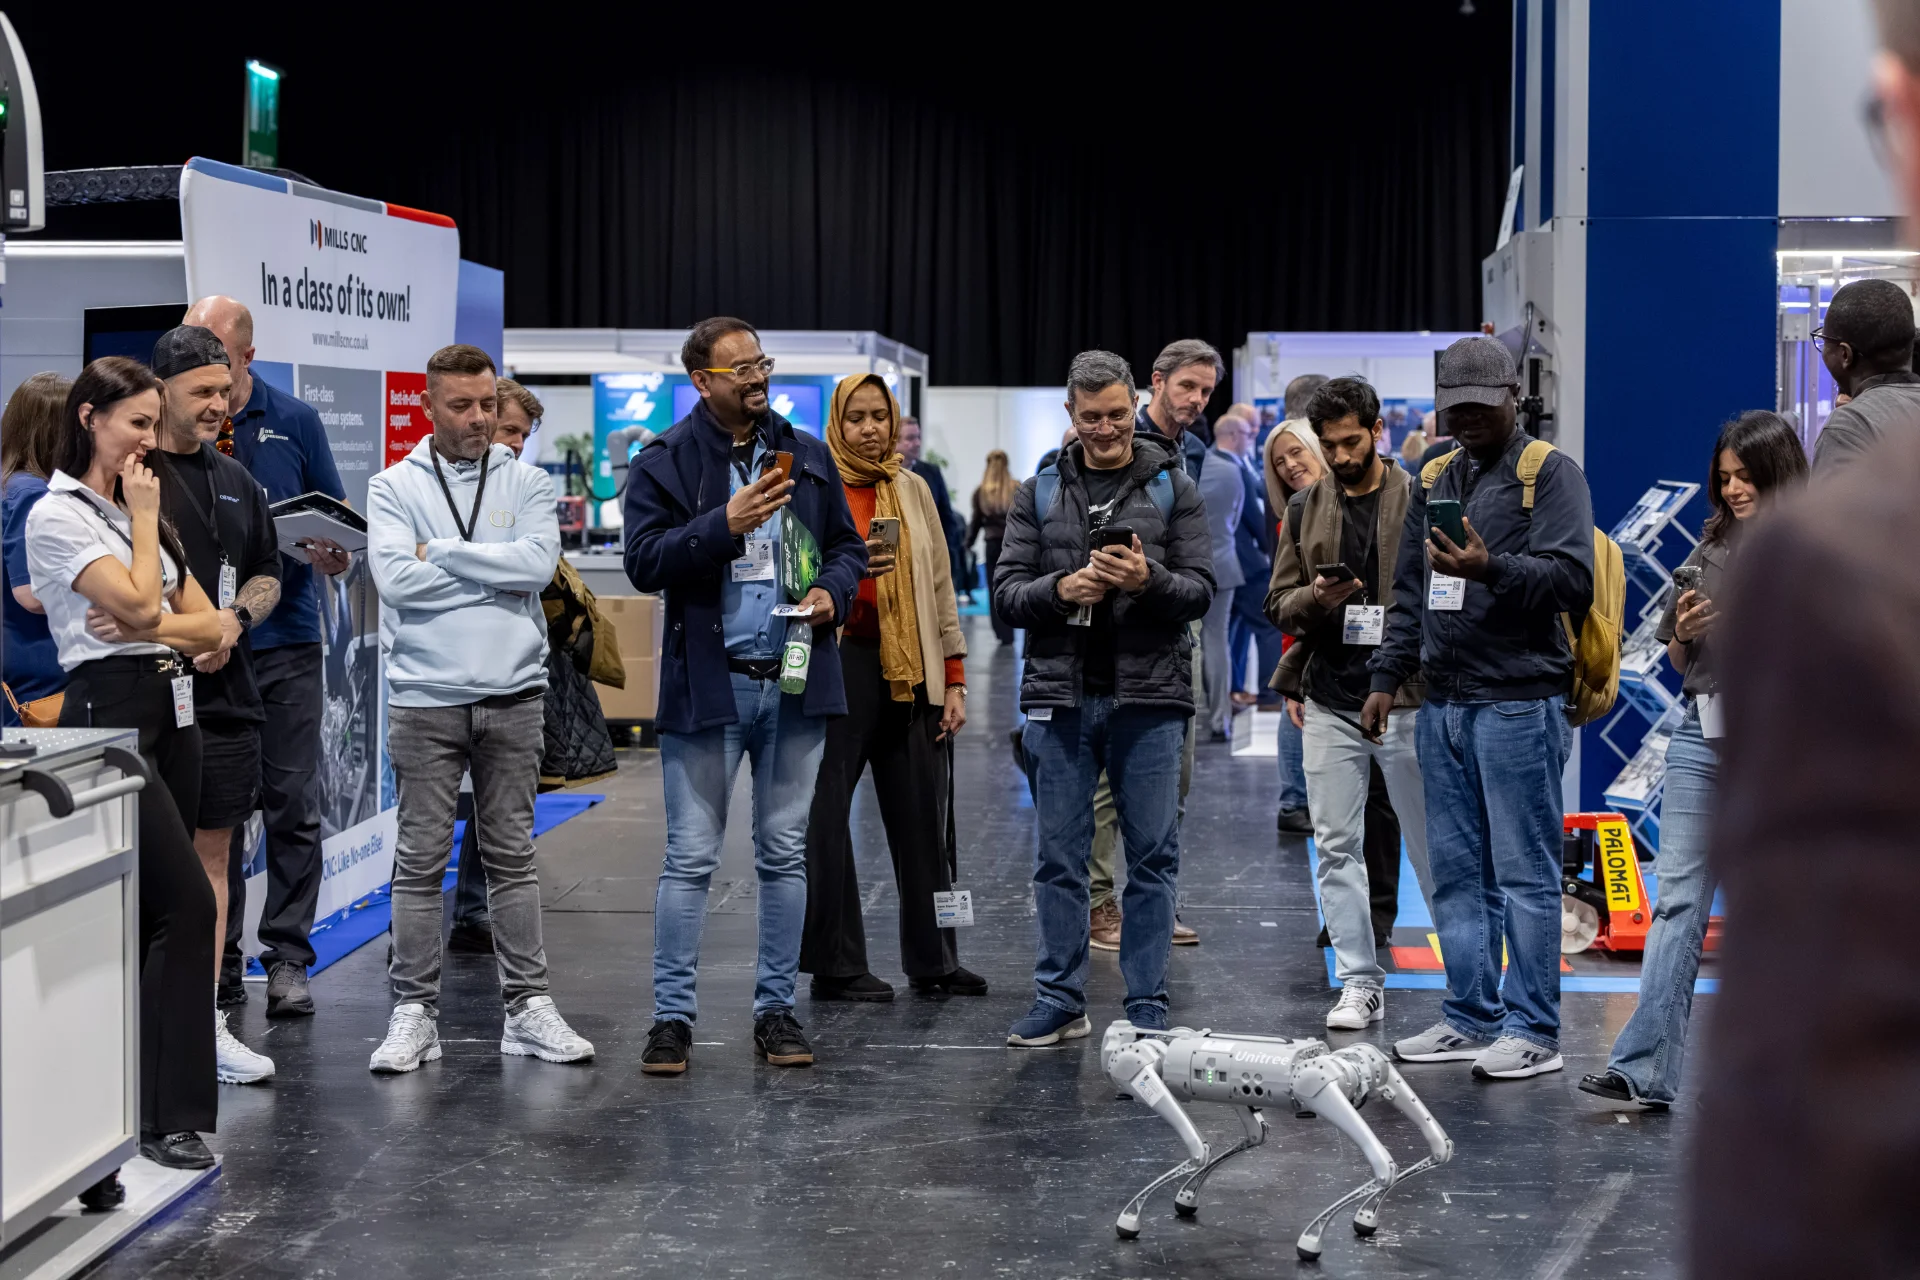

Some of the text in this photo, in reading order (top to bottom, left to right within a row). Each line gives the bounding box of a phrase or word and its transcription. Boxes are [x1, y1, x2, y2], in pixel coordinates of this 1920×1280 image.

[324, 226, 368, 254] MILLS CNC
[261, 261, 411, 322] In a class of its own!
[312, 330, 370, 350] www.millscnc.co.uk
[304, 384, 335, 403] First-class
[318, 408, 364, 431] mation systems.
[389, 412, 412, 431] support.
[323, 831, 384, 882] CNC: Like No-one Else!
[1603, 828, 1631, 903] PALOMAT
[1235, 1050, 1291, 1066] Unitree
